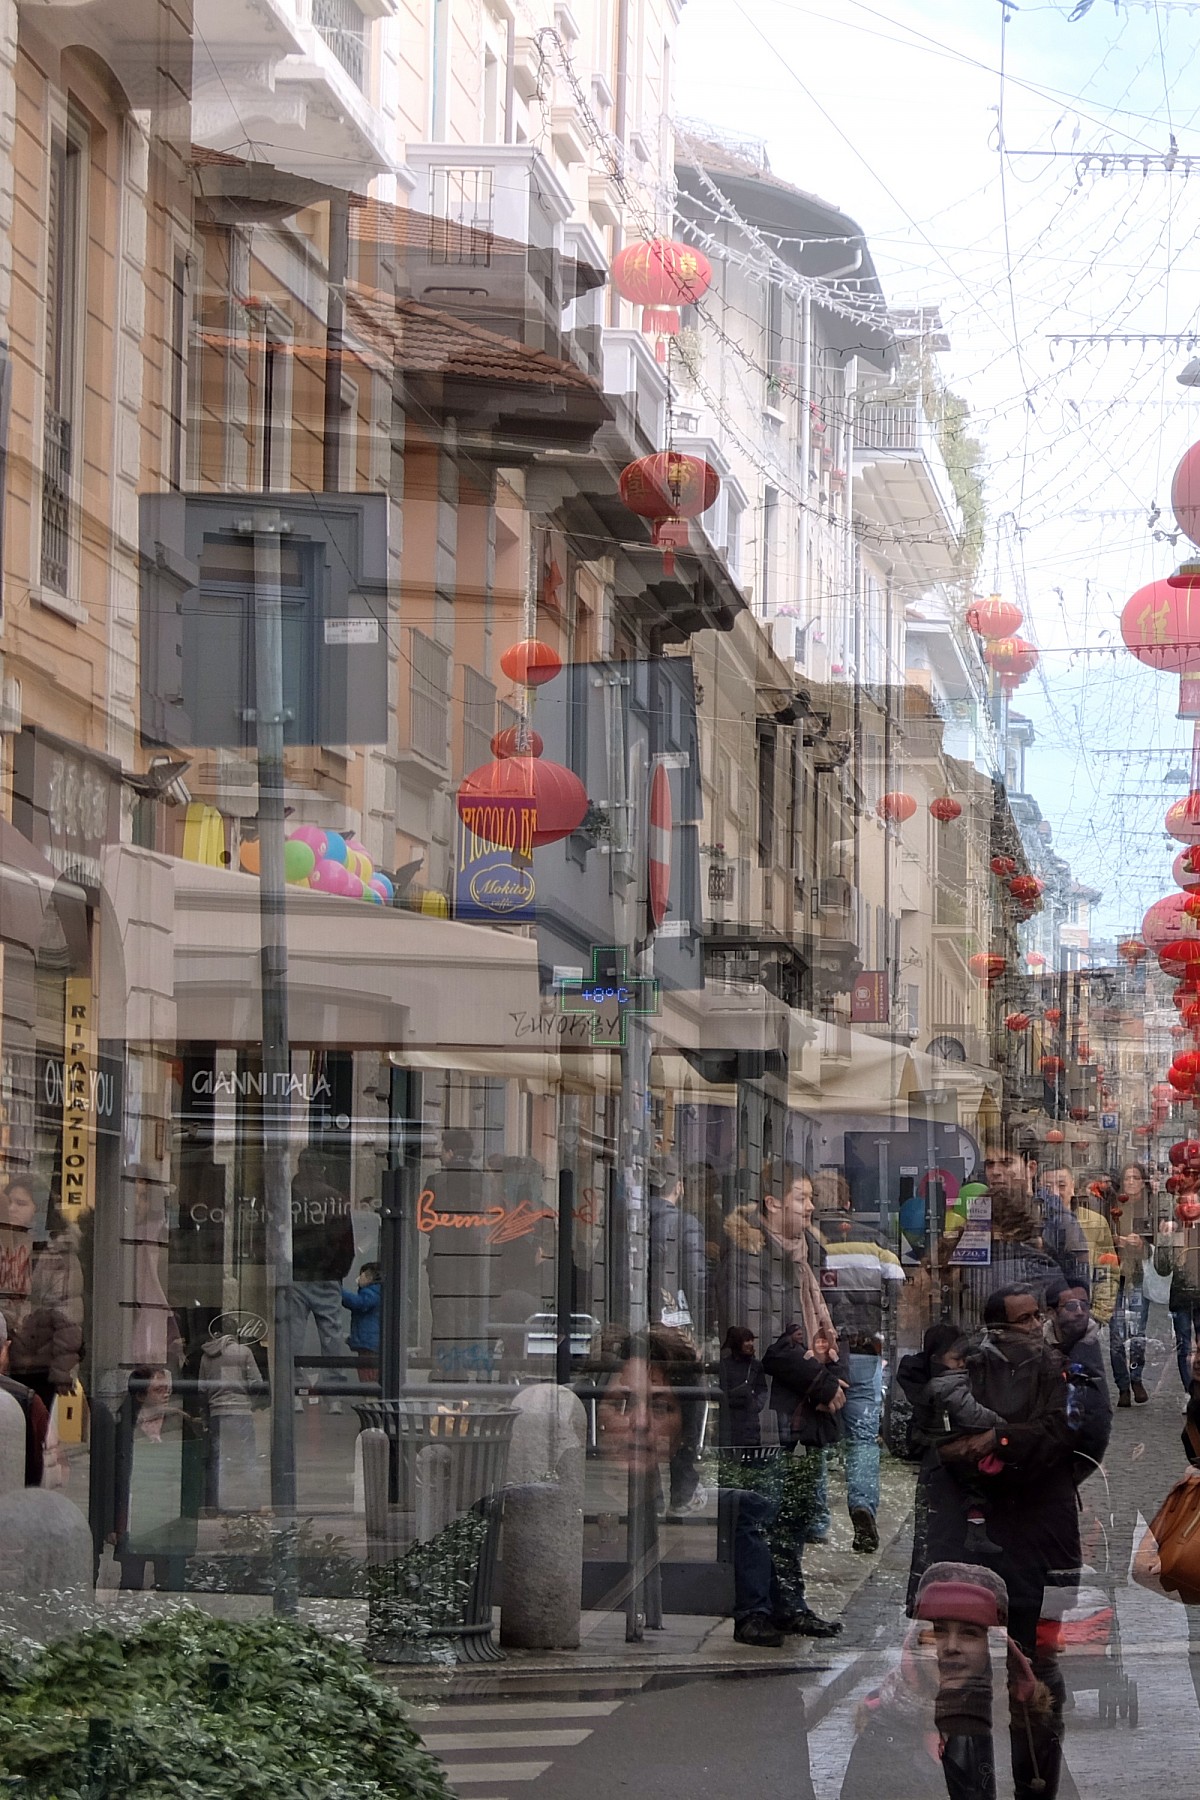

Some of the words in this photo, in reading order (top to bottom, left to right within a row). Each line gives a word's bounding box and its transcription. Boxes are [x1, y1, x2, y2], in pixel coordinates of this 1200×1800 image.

[460, 806, 517, 873] PICCOLO
[476, 879, 530, 895] Mokito
[64, 1004, 87, 1207] RIPARAZIONE
